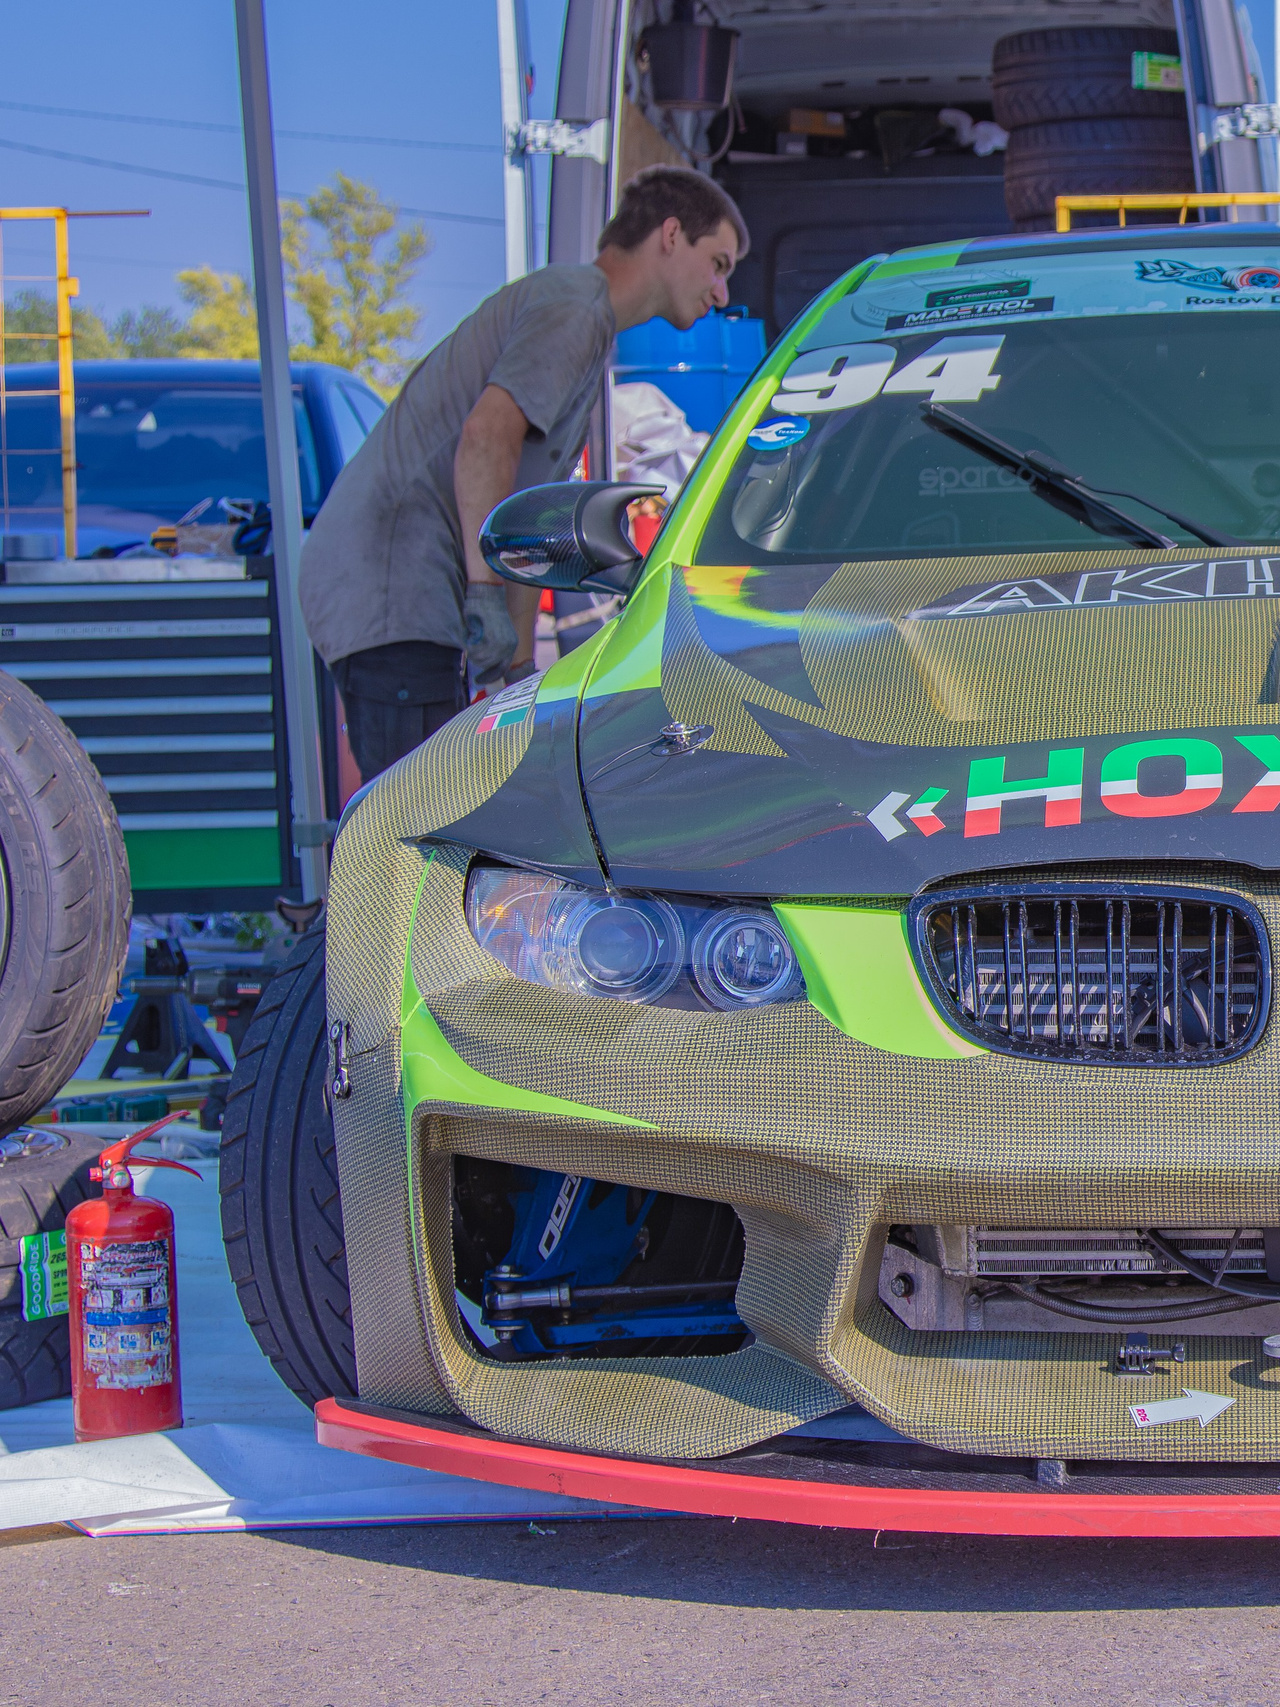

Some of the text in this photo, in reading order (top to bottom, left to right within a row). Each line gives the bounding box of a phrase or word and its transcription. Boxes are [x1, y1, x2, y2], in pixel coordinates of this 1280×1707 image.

[1186, 295, 1263, 305] Rostov
[770, 333, 1006, 414] 94
[28, 1242, 42, 1315] GOODRIDE
